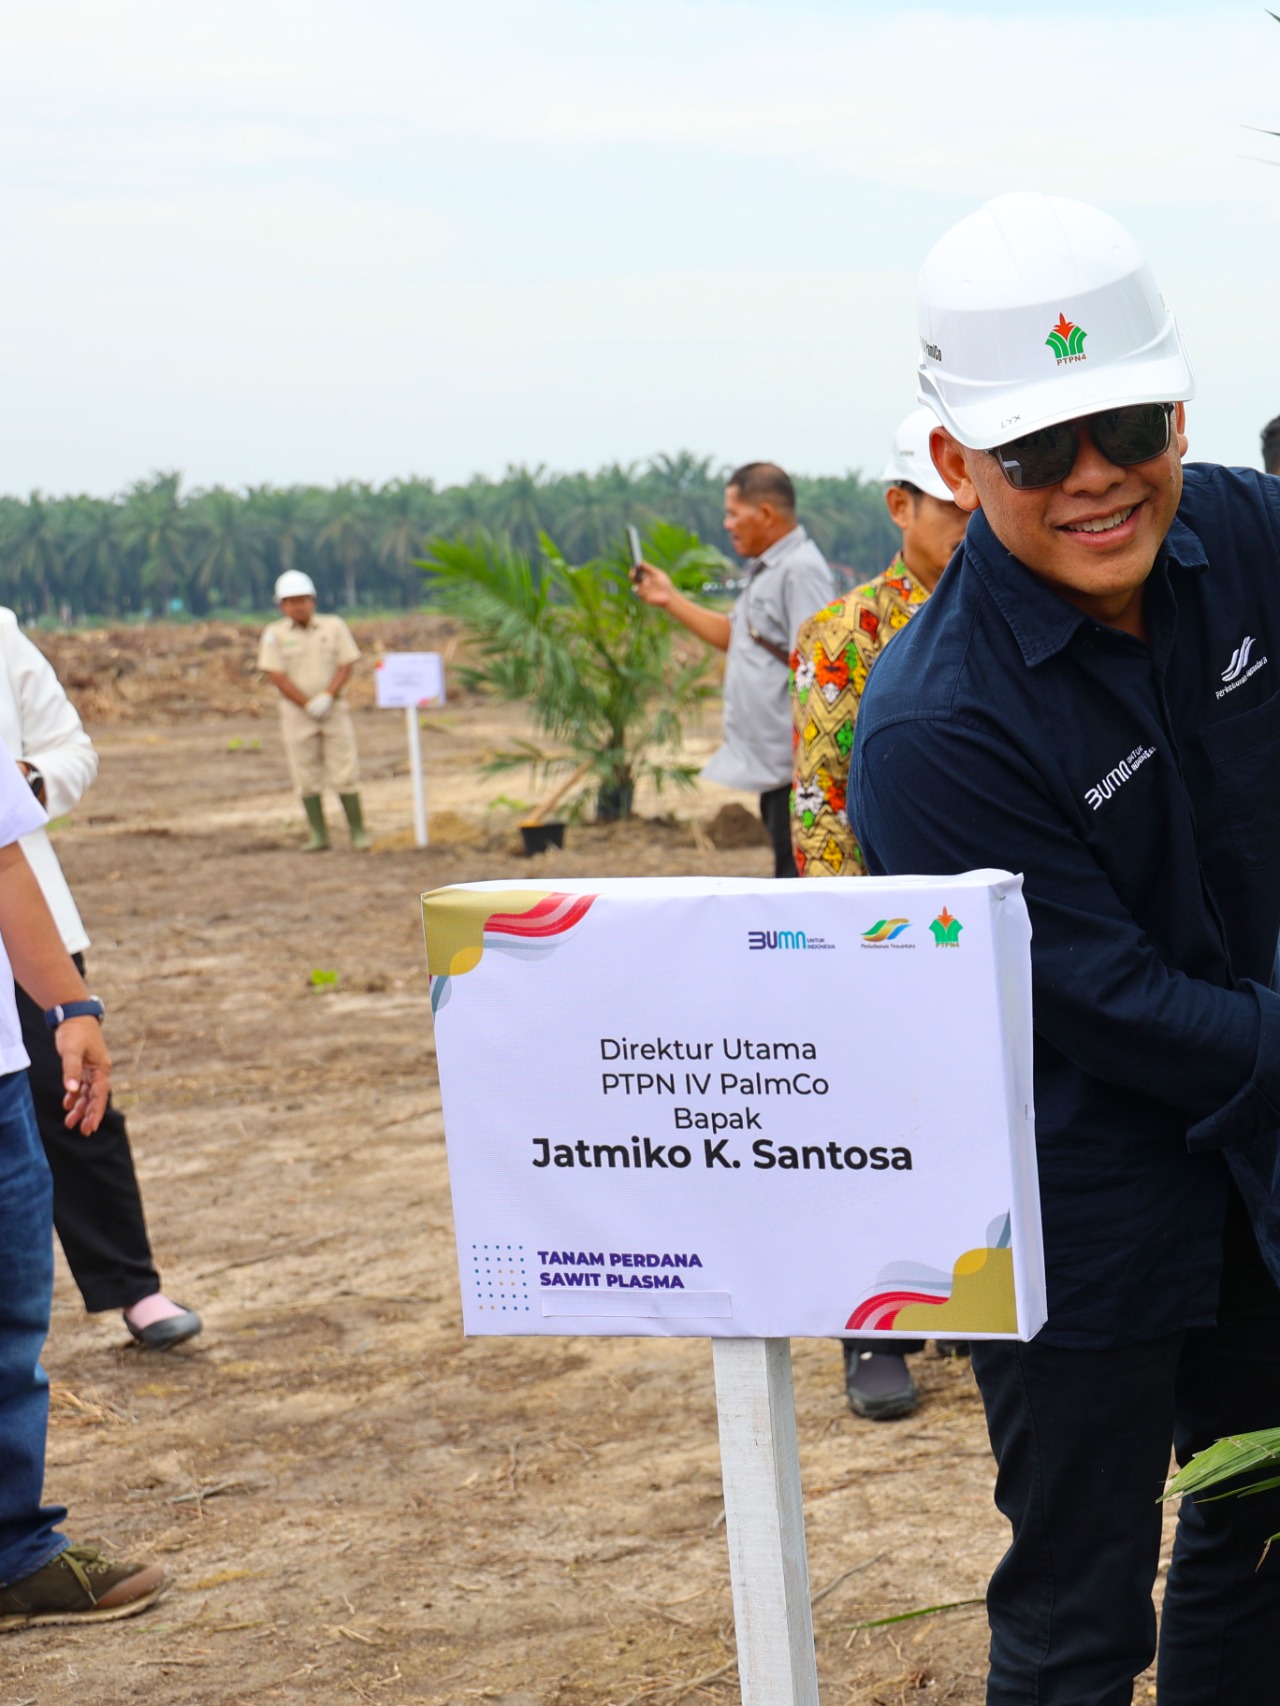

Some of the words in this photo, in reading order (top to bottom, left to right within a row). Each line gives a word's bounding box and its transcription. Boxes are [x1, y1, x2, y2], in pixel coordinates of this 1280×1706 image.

[1056, 353, 1087, 366] PTPN4
[1084, 760, 1132, 811] BUMN
[748, 930, 806, 950] BUMN
[600, 1037, 713, 1061] Direktur
[723, 1038, 817, 1060] Utama
[602, 1073, 675, 1095] PTPN
[685, 1073, 711, 1095] IV
[720, 1072, 829, 1096] PalmCo
[673, 1106, 763, 1134] Bapak
[531, 1135, 692, 1169] Jatmiko
[703, 1138, 741, 1169] K.
[752, 1138, 913, 1171] Santosa
[537, 1251, 605, 1266] TANAM
[609, 1253, 703, 1268] PERDANA
[539, 1272, 601, 1287] SAWIT
[606, 1273, 685, 1289] PLASMA
